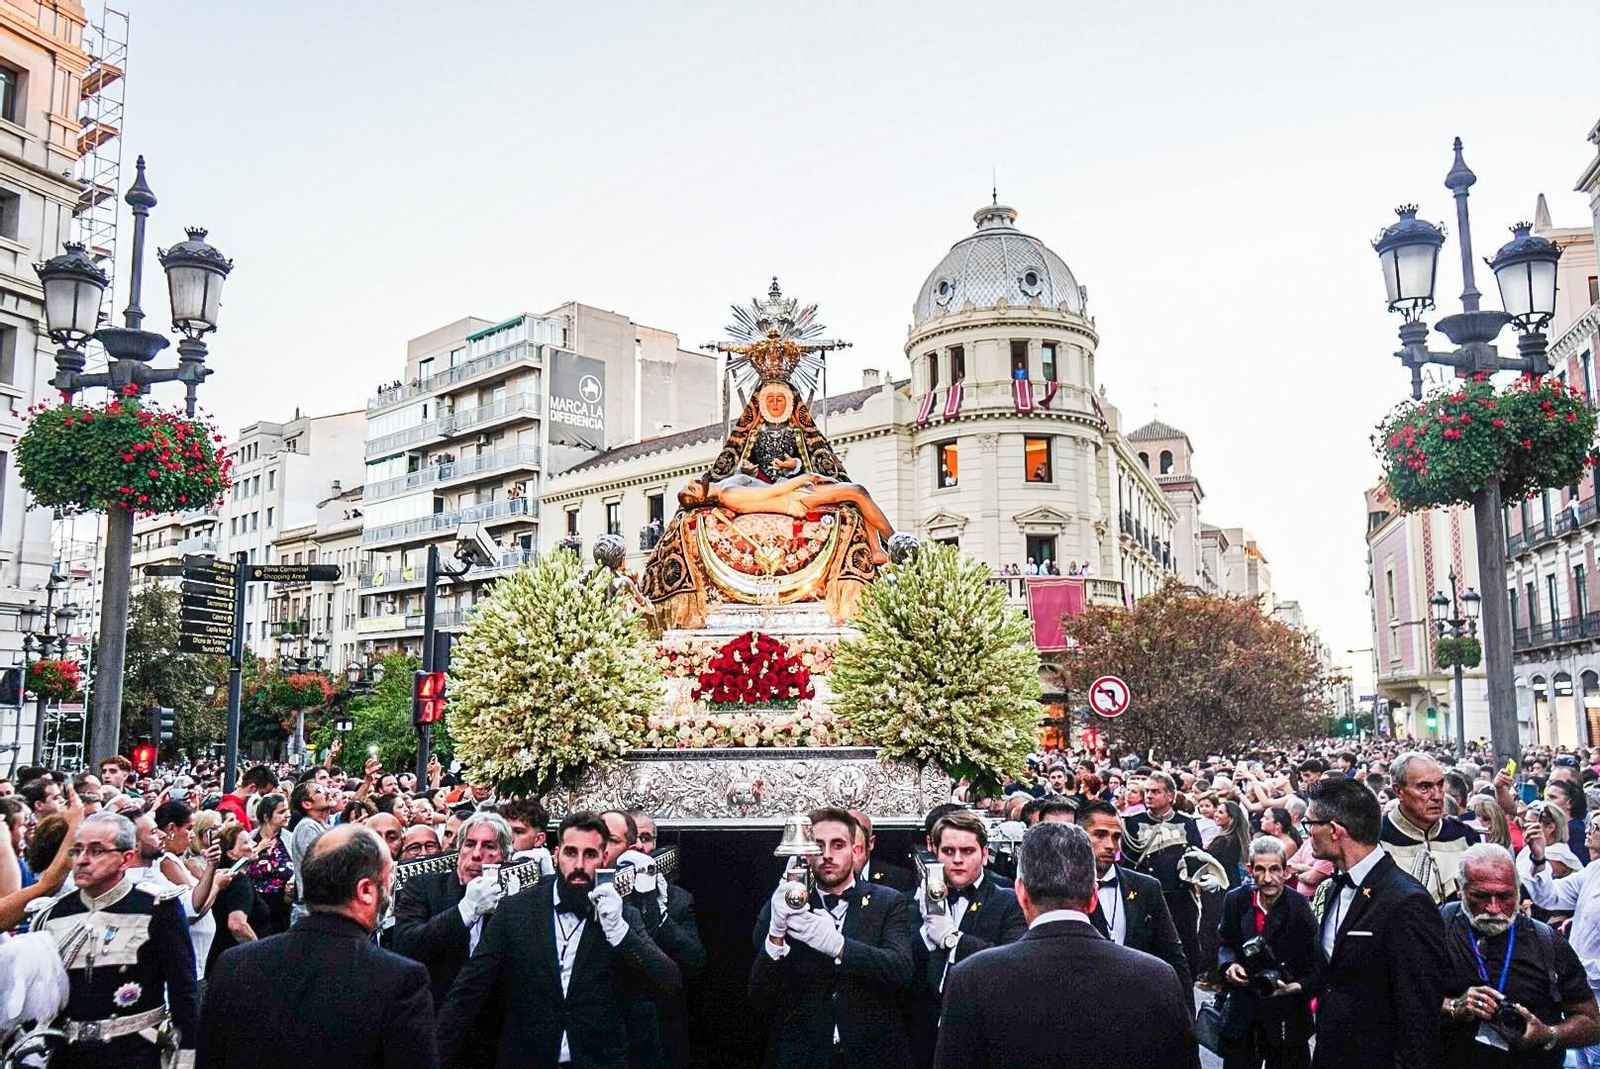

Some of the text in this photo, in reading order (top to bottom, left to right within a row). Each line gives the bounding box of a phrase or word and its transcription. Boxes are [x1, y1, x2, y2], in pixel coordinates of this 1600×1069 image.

[550, 396, 604, 419] MARCA LA
[550, 409, 604, 430] DIFERENCIA
[202, 645, 214, 653] Tourist
[212, 638, 226, 646] Turismo
